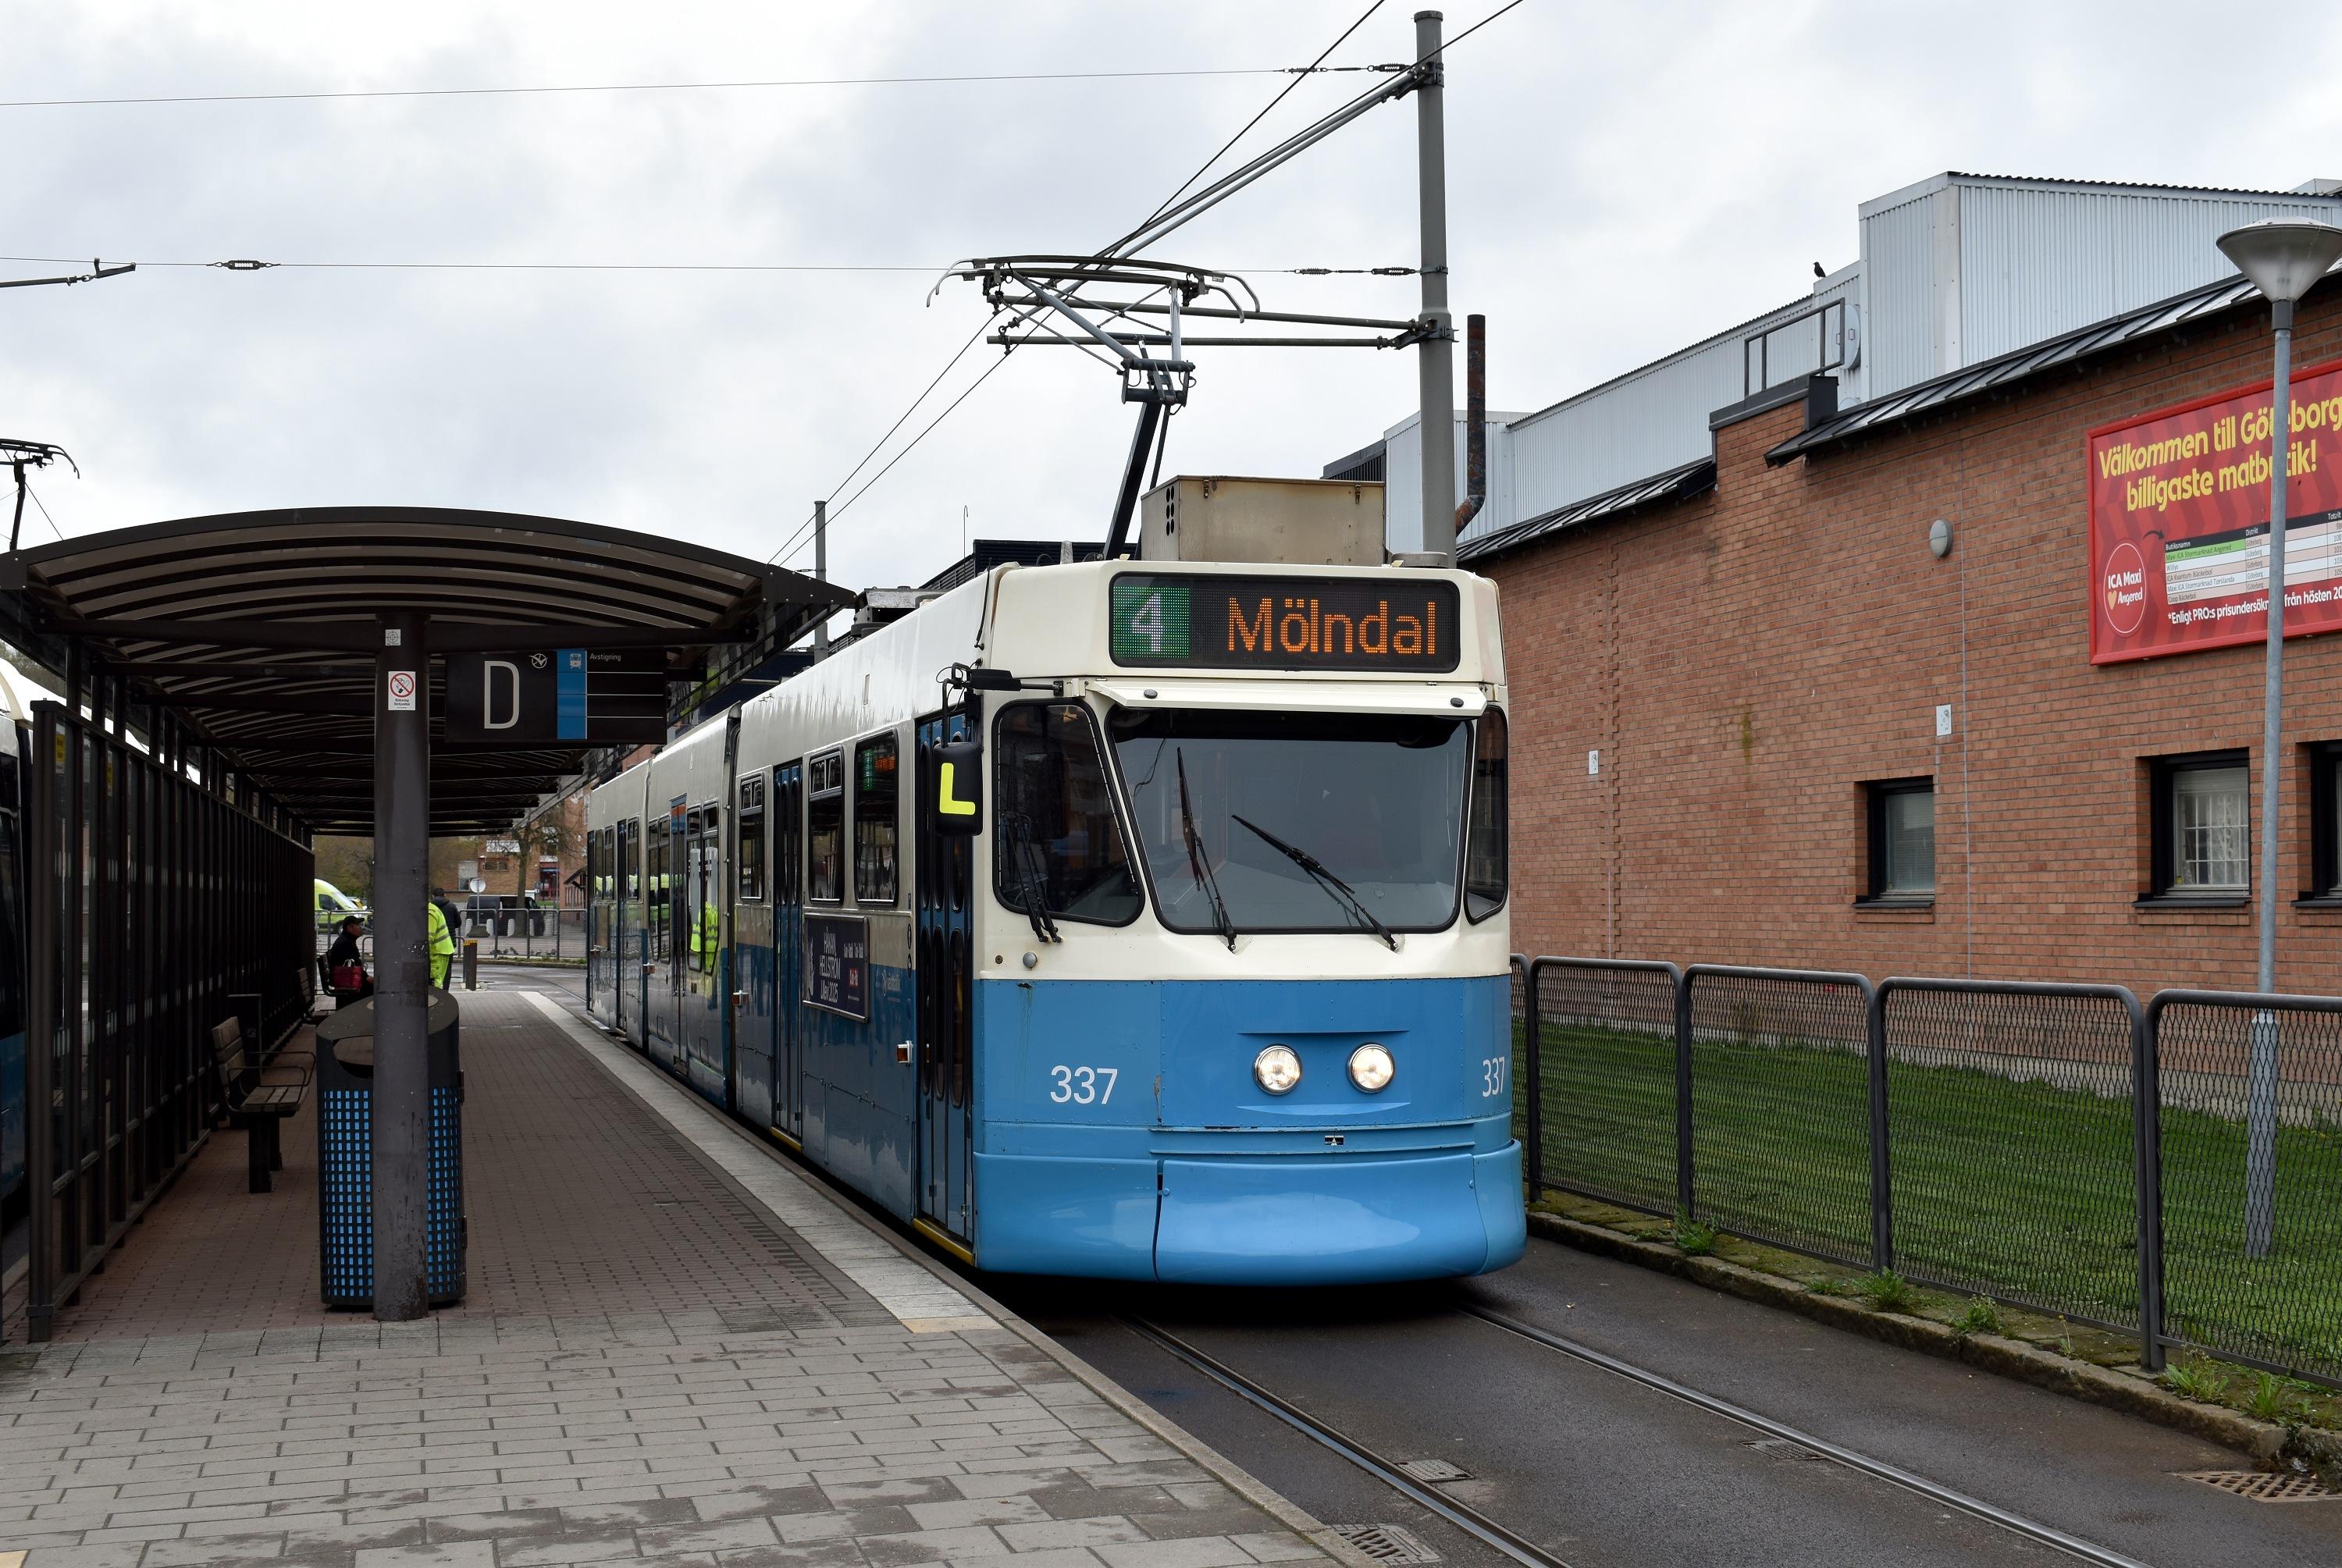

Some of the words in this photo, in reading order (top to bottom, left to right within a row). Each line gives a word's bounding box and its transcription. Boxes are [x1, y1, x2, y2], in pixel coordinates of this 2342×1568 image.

[2099, 431, 2209, 479] Välkommen
[2214, 416, 2236, 452] till
[2241, 396, 2342, 444] Götborg
[2127, 468, 2214, 512] billigaste
[2245, 527, 2258, 536] Distrikt
[2165, 541, 2191, 550] Butiksnamn
[2246, 538, 2262, 547] Göteborg
[2184, 546, 2213, 557] Stormarknad
[2213, 545, 2232, 554] Angered
[2246, 549, 2262, 558] Göteborg
[2247, 560, 2263, 569] Göteborg
[2108, 573, 2123, 589] ICA
[2123, 568, 2142, 586] Maxi
[2193, 569, 2212, 578] Bäckebol
[2248, 571, 2263, 580] Göteborg
[2185, 579, 2212, 589] Stormarknad
[2213, 576, 2235, 585] Torslanda
[2248, 581, 2264, 591] Göteborg
[2117, 587, 2143, 606] Angered
[2179, 592, 2196, 602] Bäckebol
[2193, 606, 2216, 620] PRO:s
[2217, 598, 2269, 620] prisundersökn
[2284, 592, 2302, 607] från
[2303, 589, 2332, 605] hösten
[1132, 592, 1164, 652] 4
[1227, 597, 1436, 655] Mölndal
[589, 652, 621, 662] Avstigning
[483, 660, 521, 730] D
[1482, 1056, 1506, 1097] 337
[1050, 1065, 1118, 1105] 337
